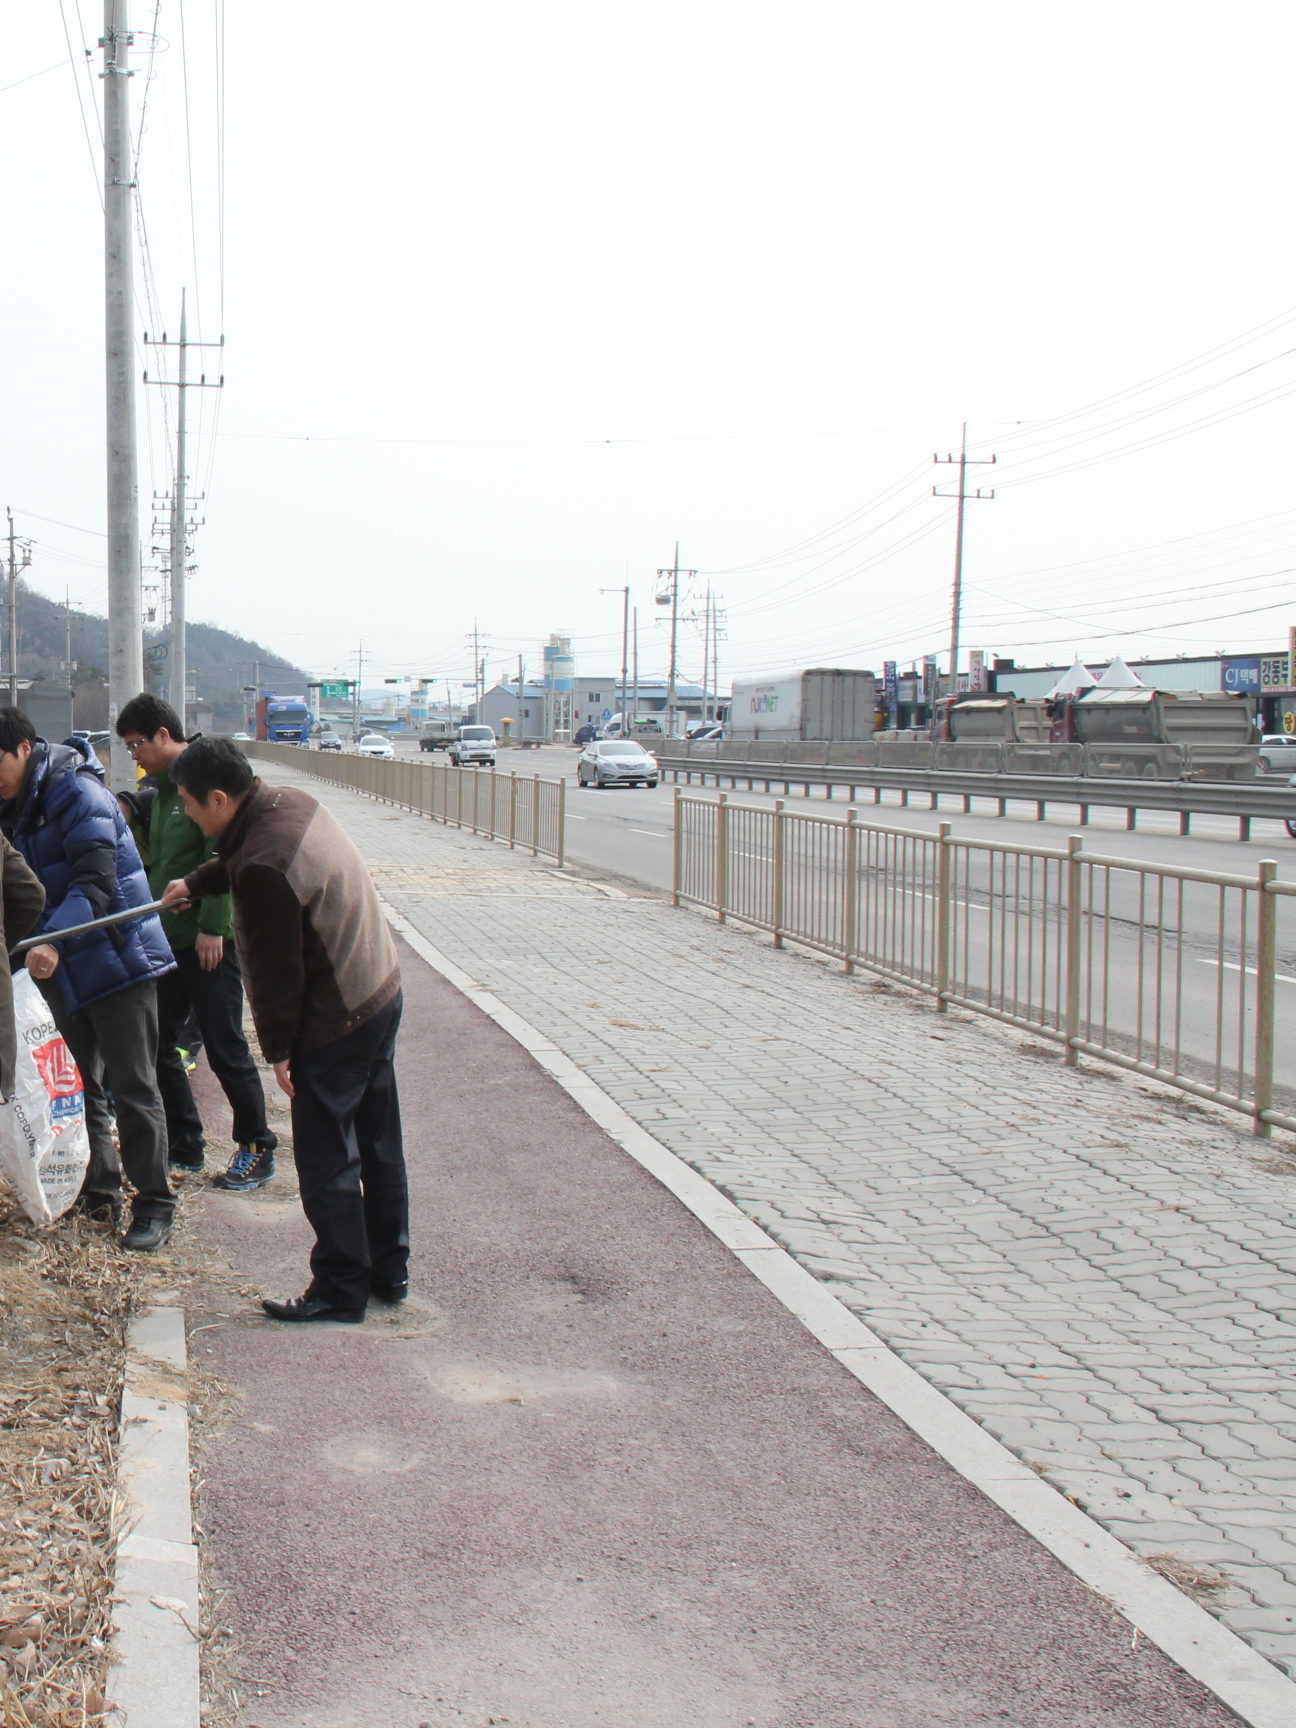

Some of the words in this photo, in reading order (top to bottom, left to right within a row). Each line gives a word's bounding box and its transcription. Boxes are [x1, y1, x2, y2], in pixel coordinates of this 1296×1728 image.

[1225, 668, 1239, 686] CJ
[1240, 668, 1258, 685] 택배
[22, 1021, 57, 1045] KOPE
